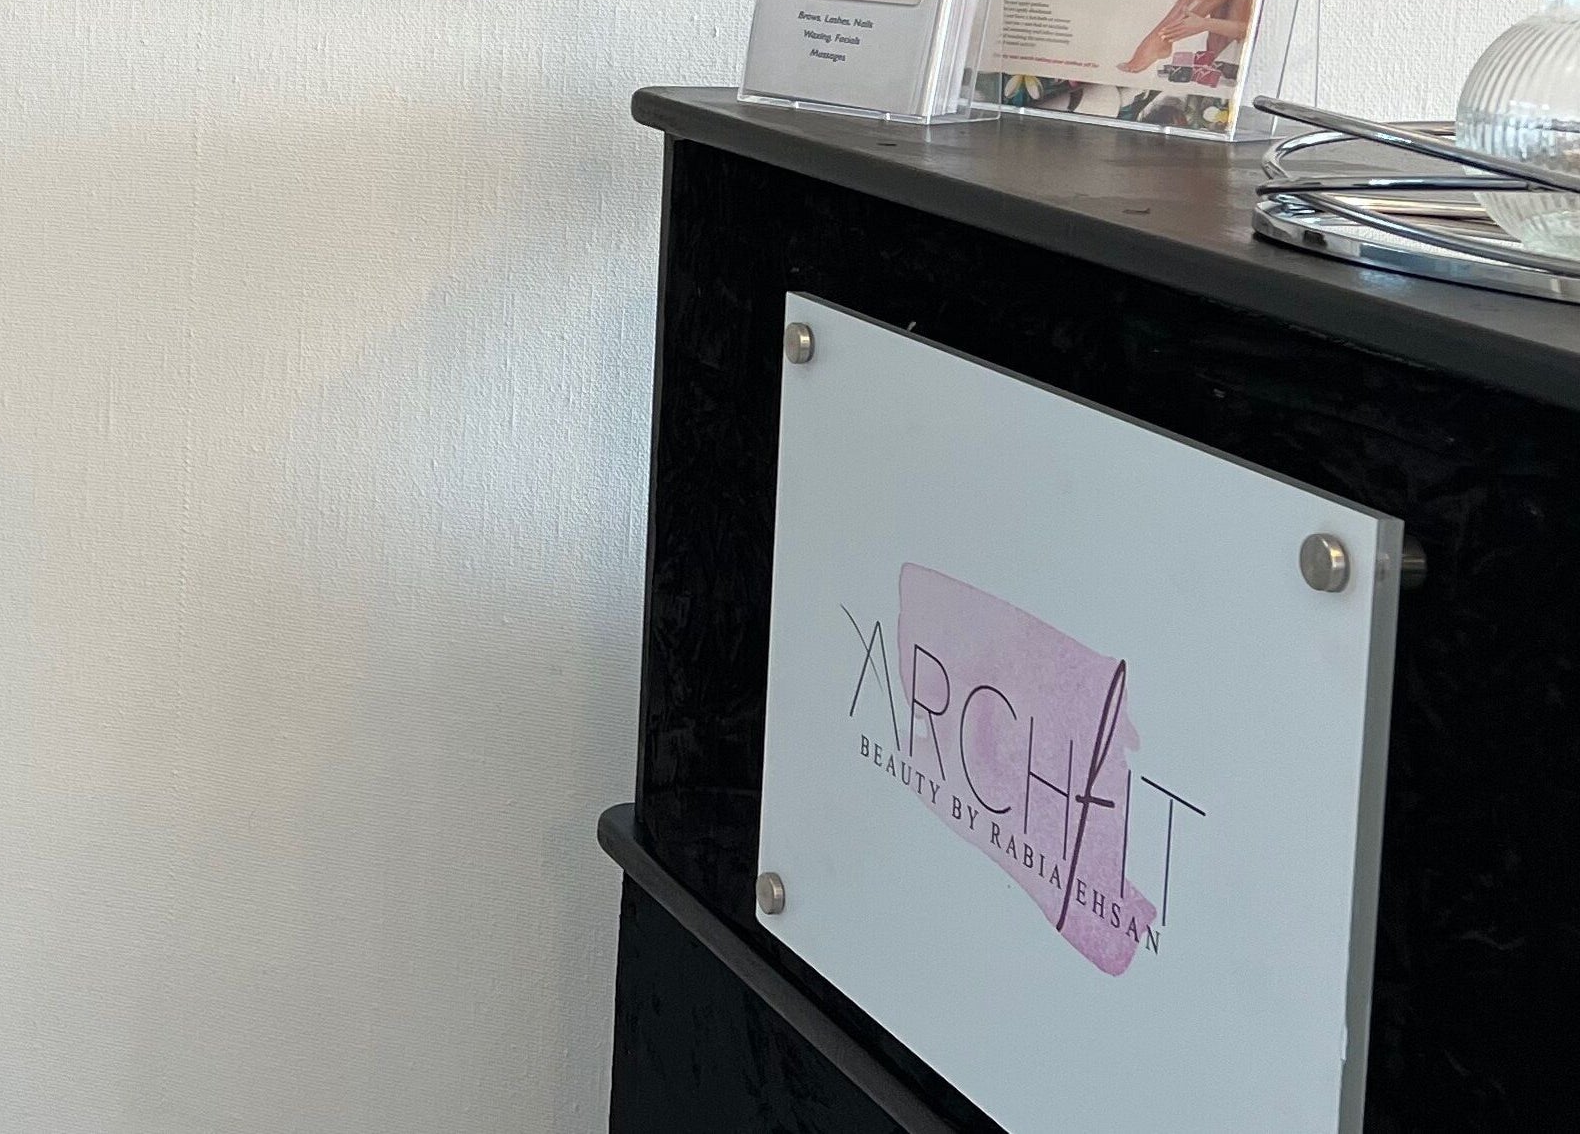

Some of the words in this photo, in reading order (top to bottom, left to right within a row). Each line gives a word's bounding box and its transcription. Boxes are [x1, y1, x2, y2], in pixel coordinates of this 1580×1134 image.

[853, 19, 873, 28] Nails
[860, 734, 941, 805] BEAUTY
[951, 794, 979, 831] BY
[990, 821, 1064, 891] RABIA
[1076, 878, 1161, 955] EHSAN
